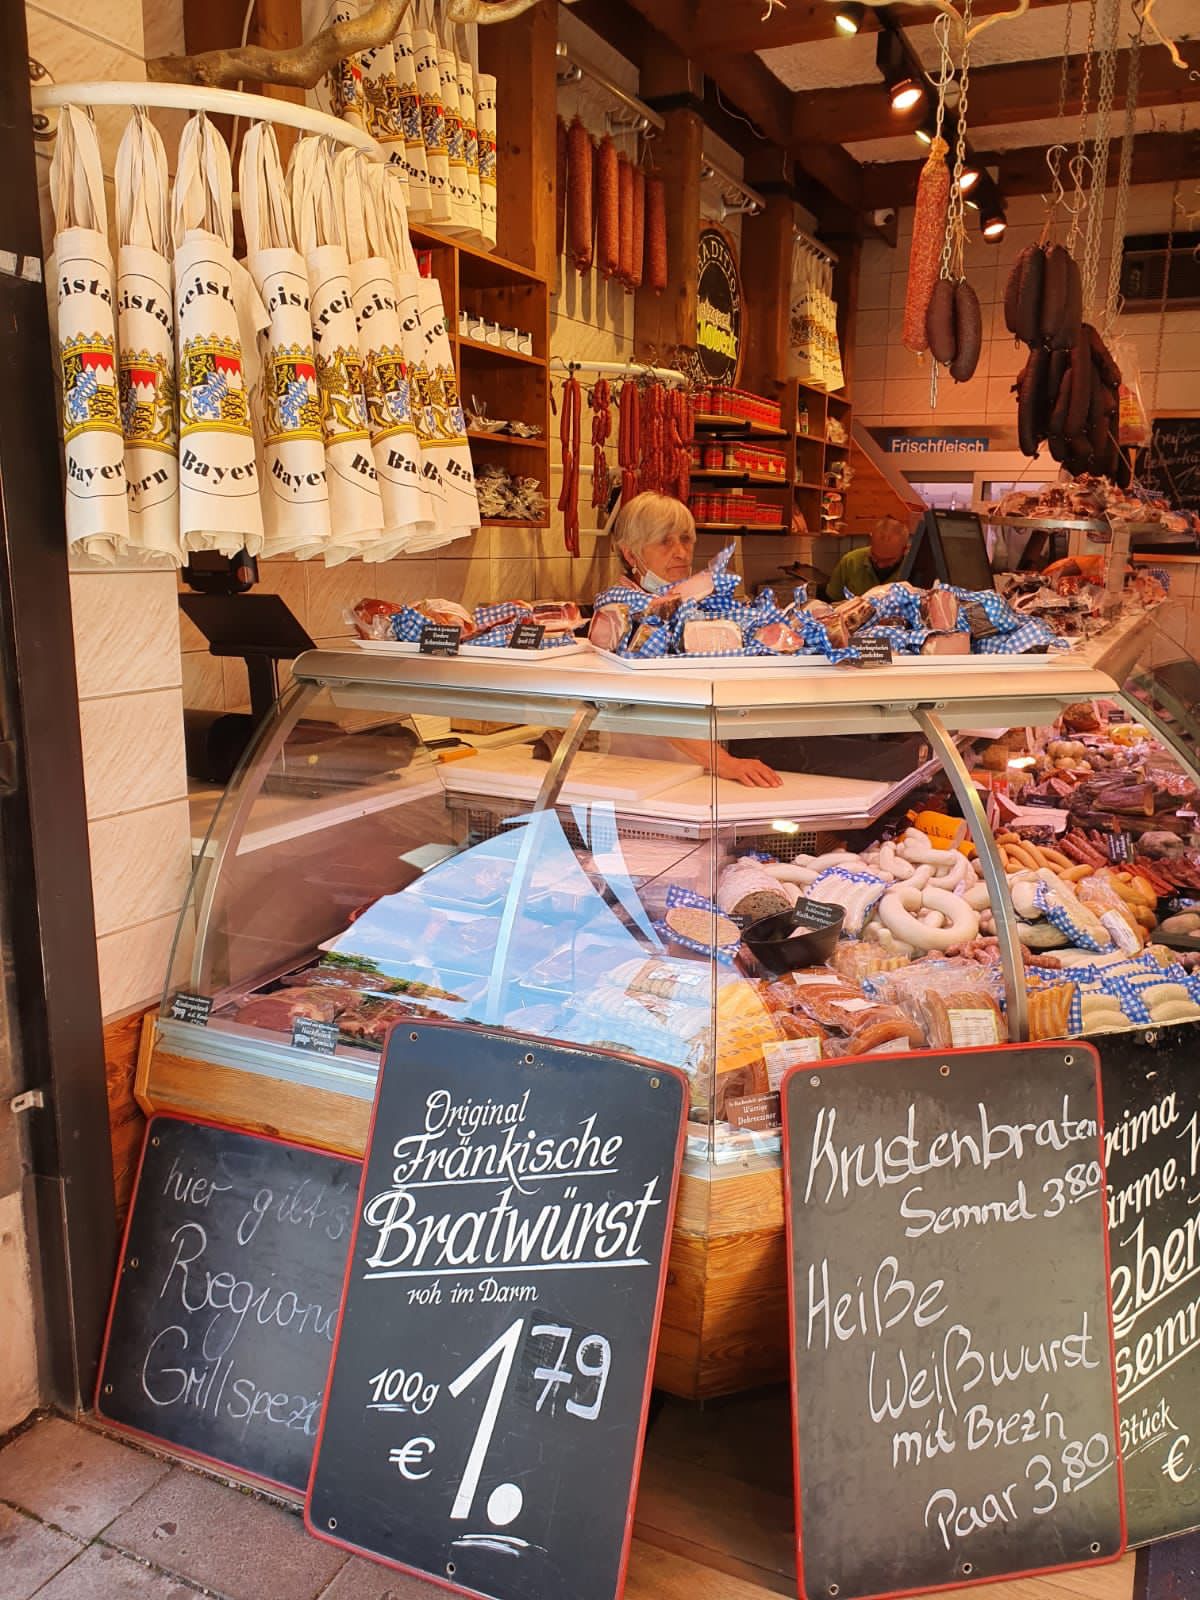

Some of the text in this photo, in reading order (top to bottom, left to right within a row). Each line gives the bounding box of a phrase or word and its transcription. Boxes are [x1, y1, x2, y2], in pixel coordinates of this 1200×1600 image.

[478, 97, 496, 111] ei
[400, 309, 422, 332] ei
[181, 449, 257, 485] Bayer
[891, 439, 985, 453] Frischfleisch
[425, 1088, 531, 1137] Original
[1104, 1092, 1180, 1168] rima
[393, 1113, 624, 1194] Fränkische
[804, 1094, 1097, 1204] Krustenbraten
[164, 1158, 233, 1207] hier
[363, 1176, 662, 1268] Bratwürst
[407, 1276, 539, 1305] roh im Darm
[806, 1255, 949, 1350] Heiße
[368, 1368, 440, 1415] 100g
[868, 1312, 1099, 1424] Weißwurst
[893, 1407, 956, 1468] mit
[1119, 1397, 1179, 1453] Stück
[388, 1437, 436, 1480] €
[1161, 1434, 1193, 1483] €
[925, 1482, 1017, 1551] Paar
